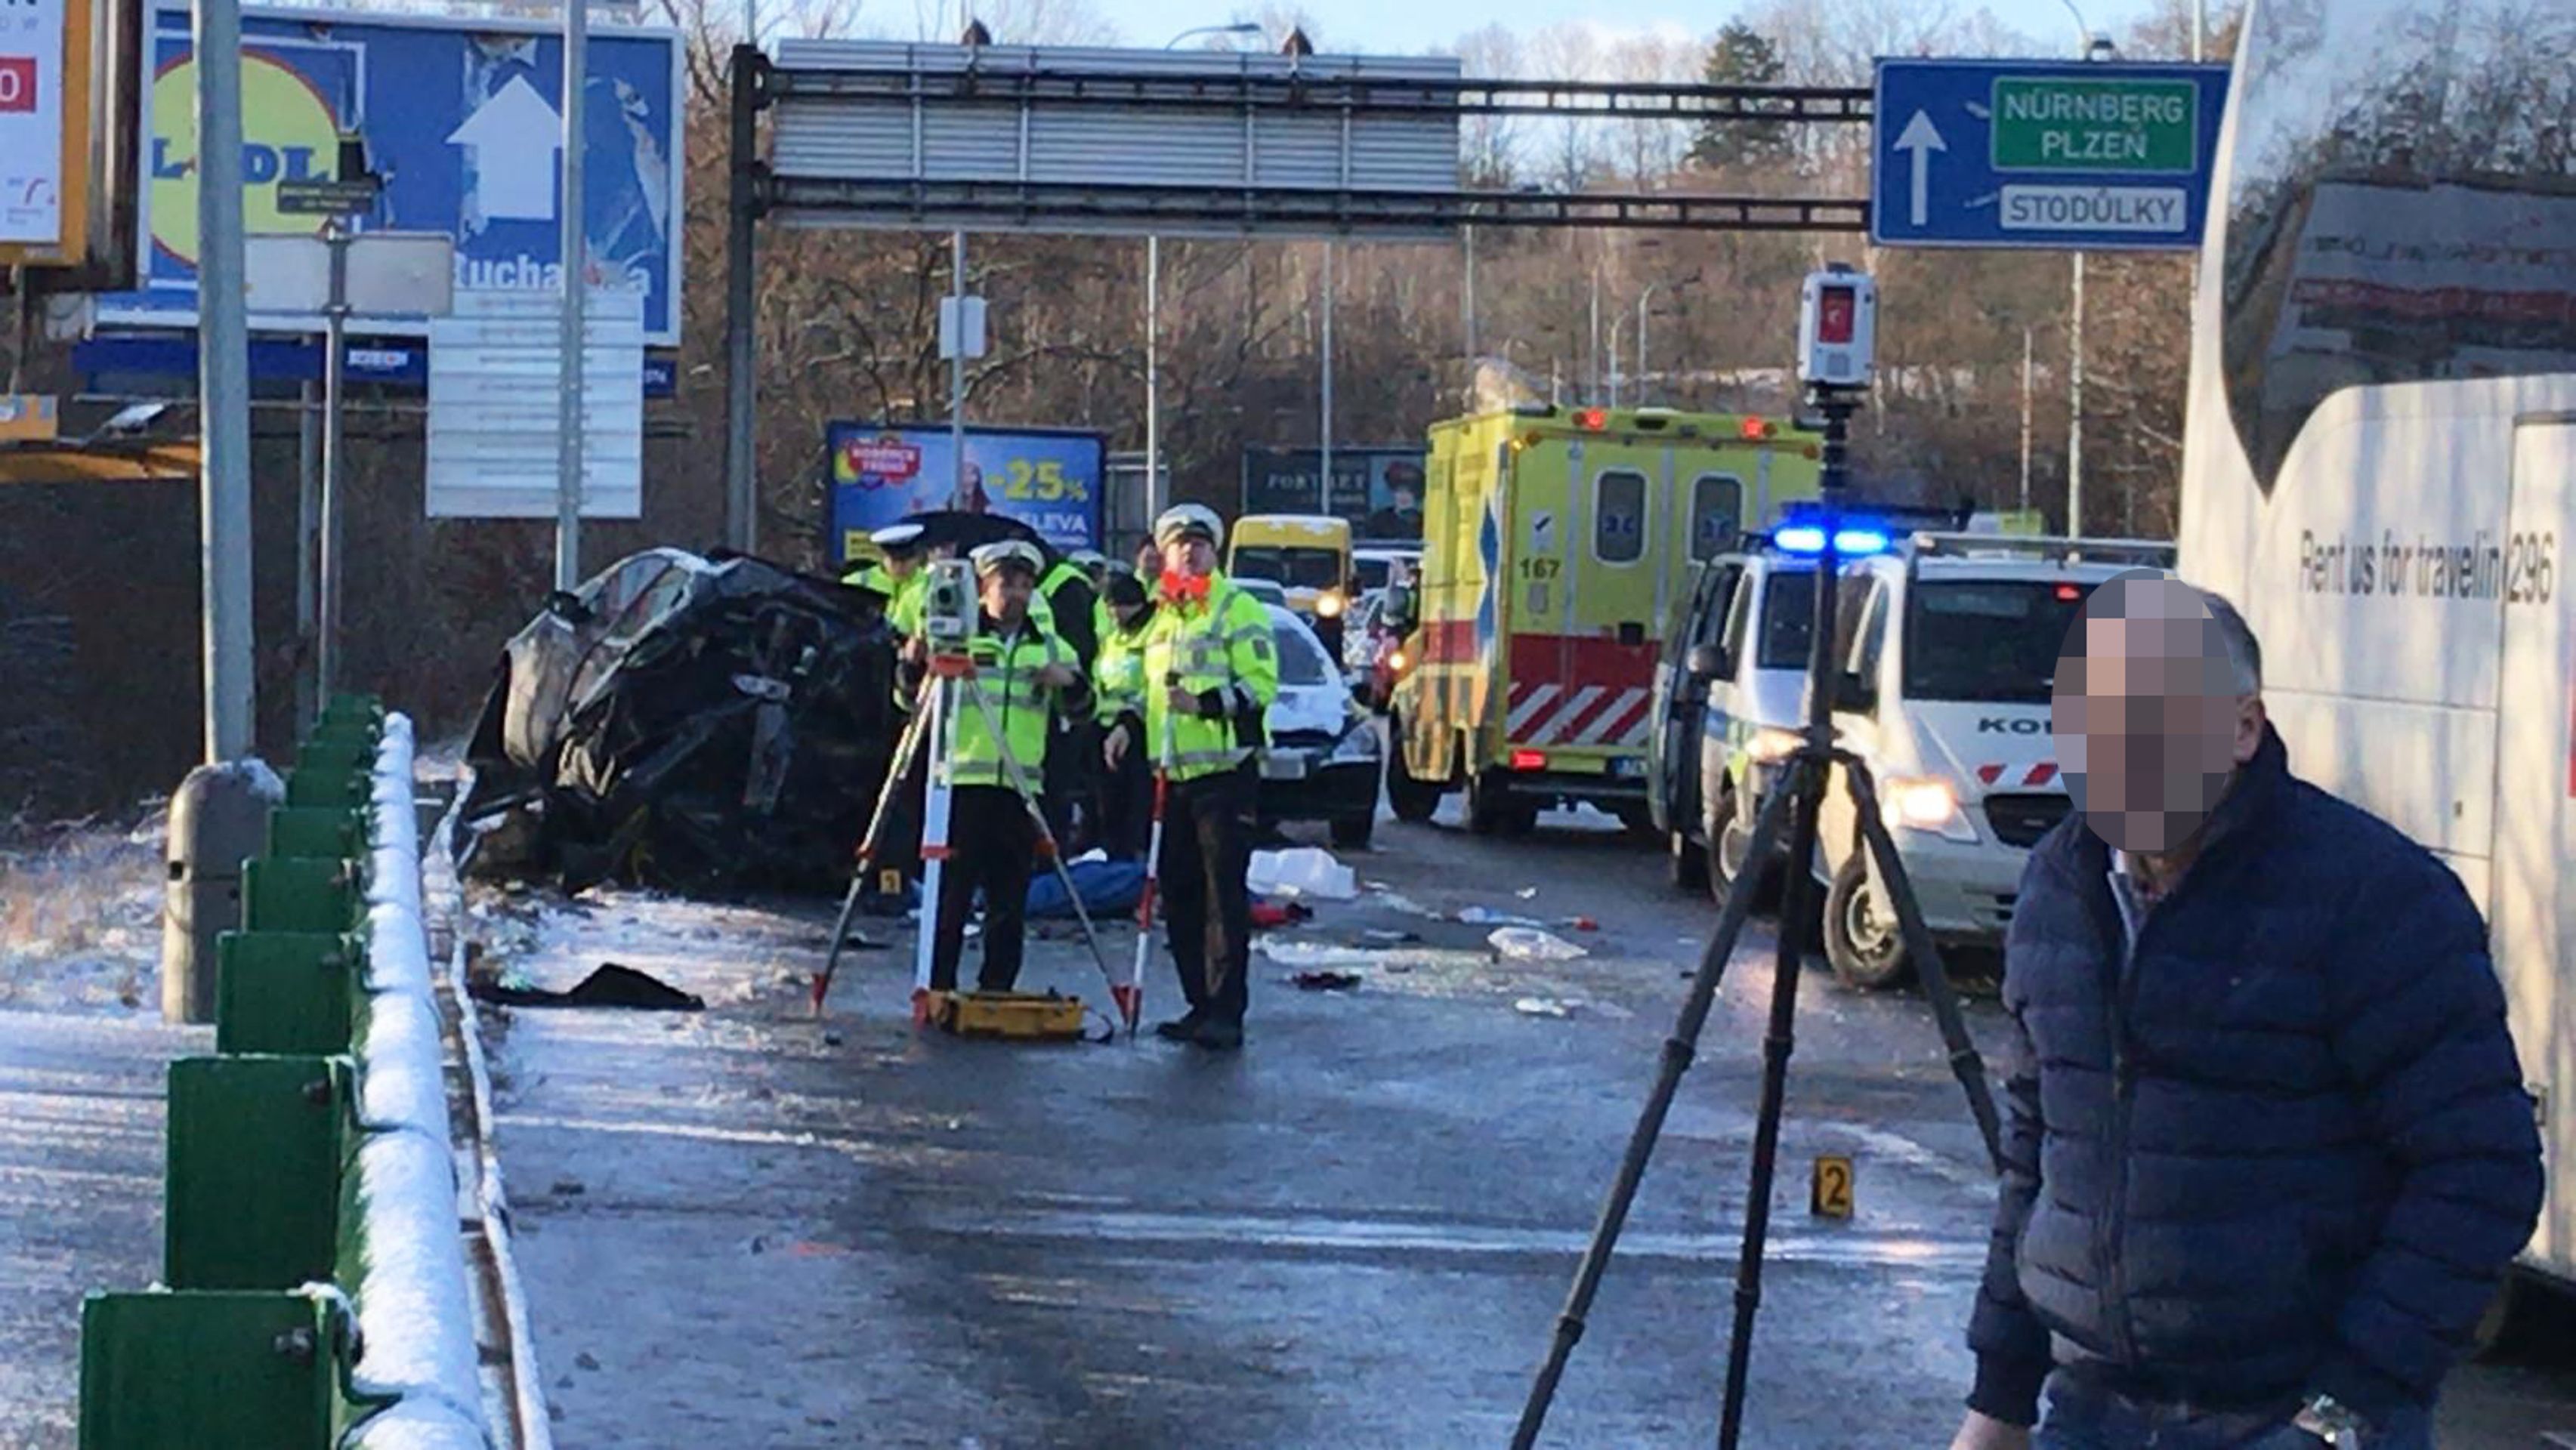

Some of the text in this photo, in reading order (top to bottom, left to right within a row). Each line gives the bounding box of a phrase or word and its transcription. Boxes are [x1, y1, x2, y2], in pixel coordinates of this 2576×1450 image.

[2005, 88, 2185, 123] NÜRNBERG
[2043, 121, 2148, 160] PLZEŇ
[152, 137, 330, 184] LDL
[2009, 187, 2176, 224] STODŮLKY
[1519, 558, 1560, 580] 167
[2300, 529, 2345, 594] Rent
[2350, 545, 2374, 594] us
[2381, 529, 2412, 596] for
[2510, 532, 2554, 603] 296
[1825, 1166, 1847, 1205] 2
